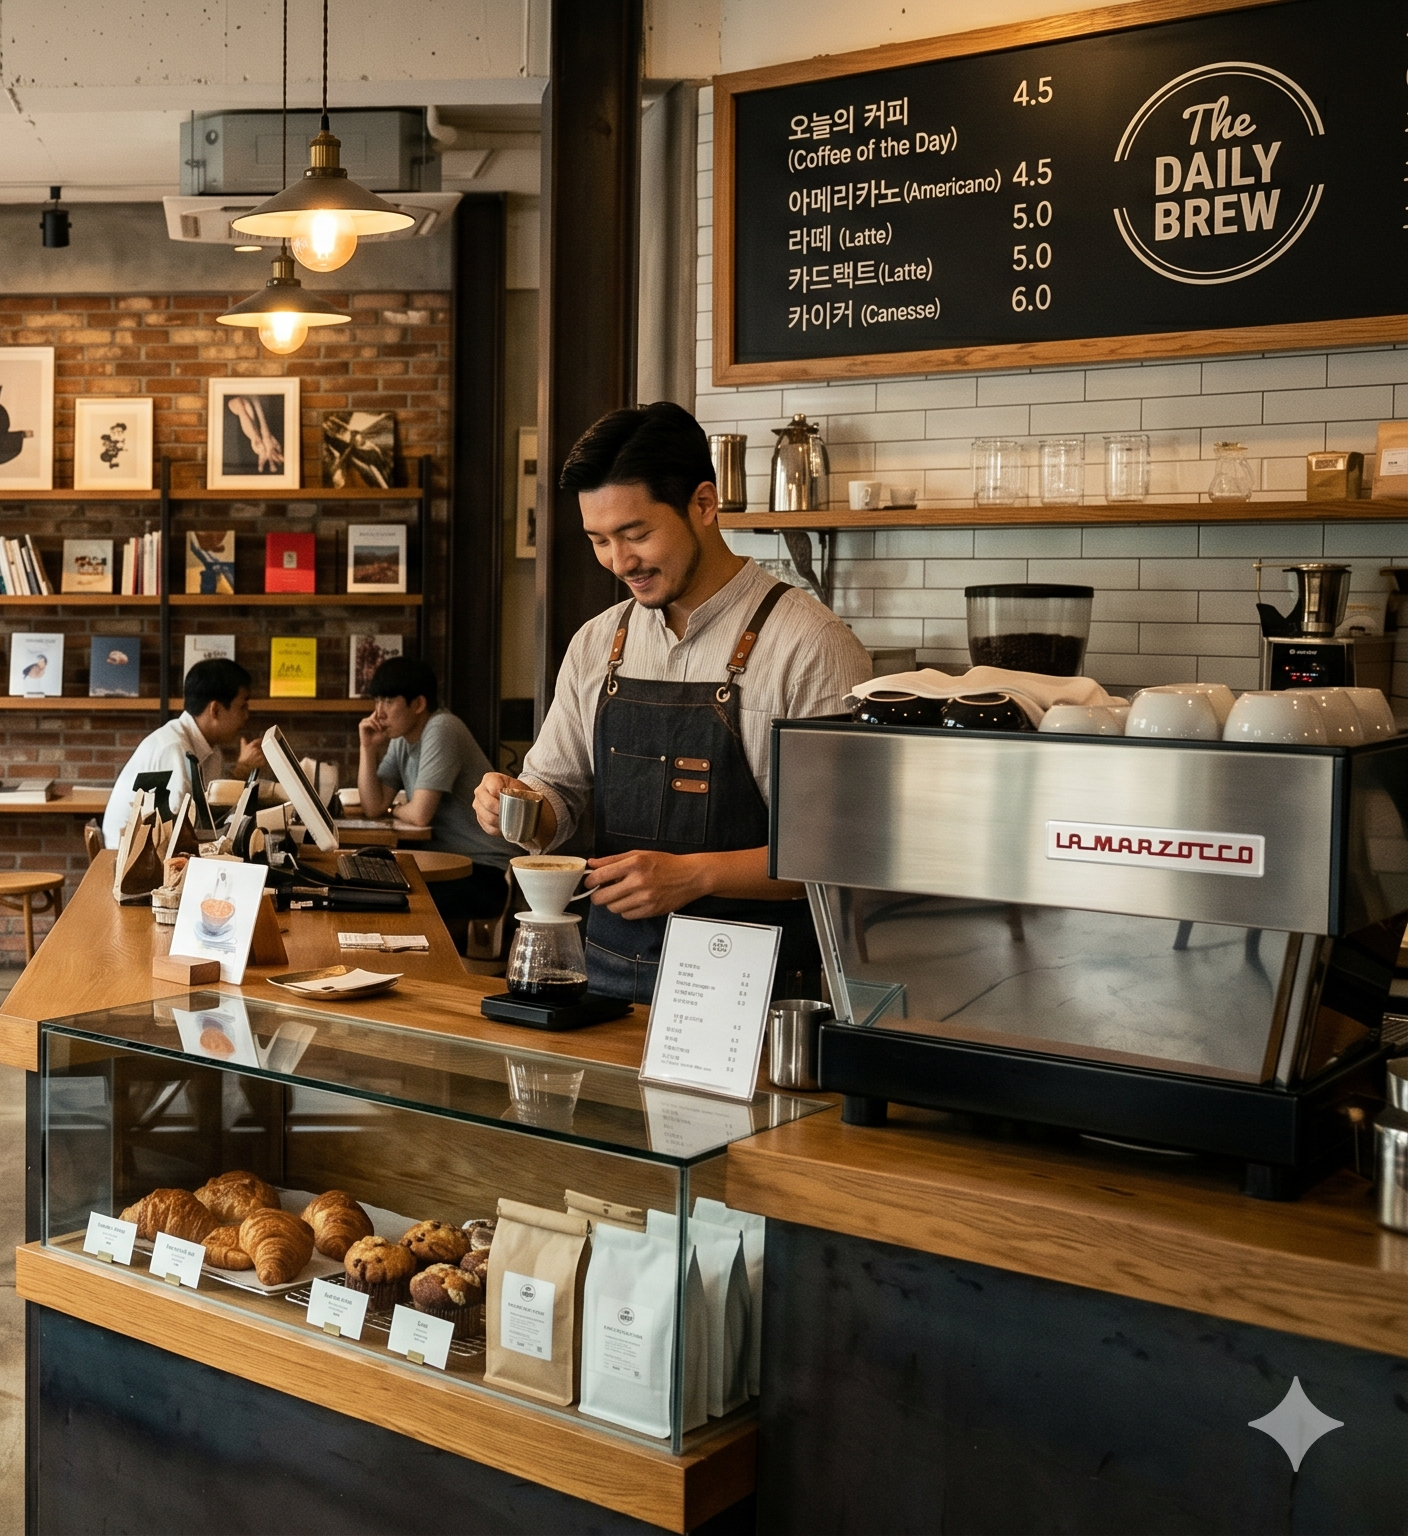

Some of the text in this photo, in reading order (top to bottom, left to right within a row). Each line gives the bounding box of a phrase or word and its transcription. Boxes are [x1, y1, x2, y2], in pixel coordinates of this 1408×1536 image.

[788, 75, 1054, 140] 오늘의 커피 4.5
[1182, 95, 1257, 146] The
[788, 126, 958, 173] (Coffee of the Day)
[1012, 158, 1053, 187] 4.5
[1155, 141, 1282, 195] DAILY
[788, 200, 1053, 255] 라떼 (Latte) 5.0
[1155, 188, 1281, 241] BREW
[1012, 242, 1052, 271] 5.0
[788, 284, 1052, 331] 카이커 (Canesse) 6.0
